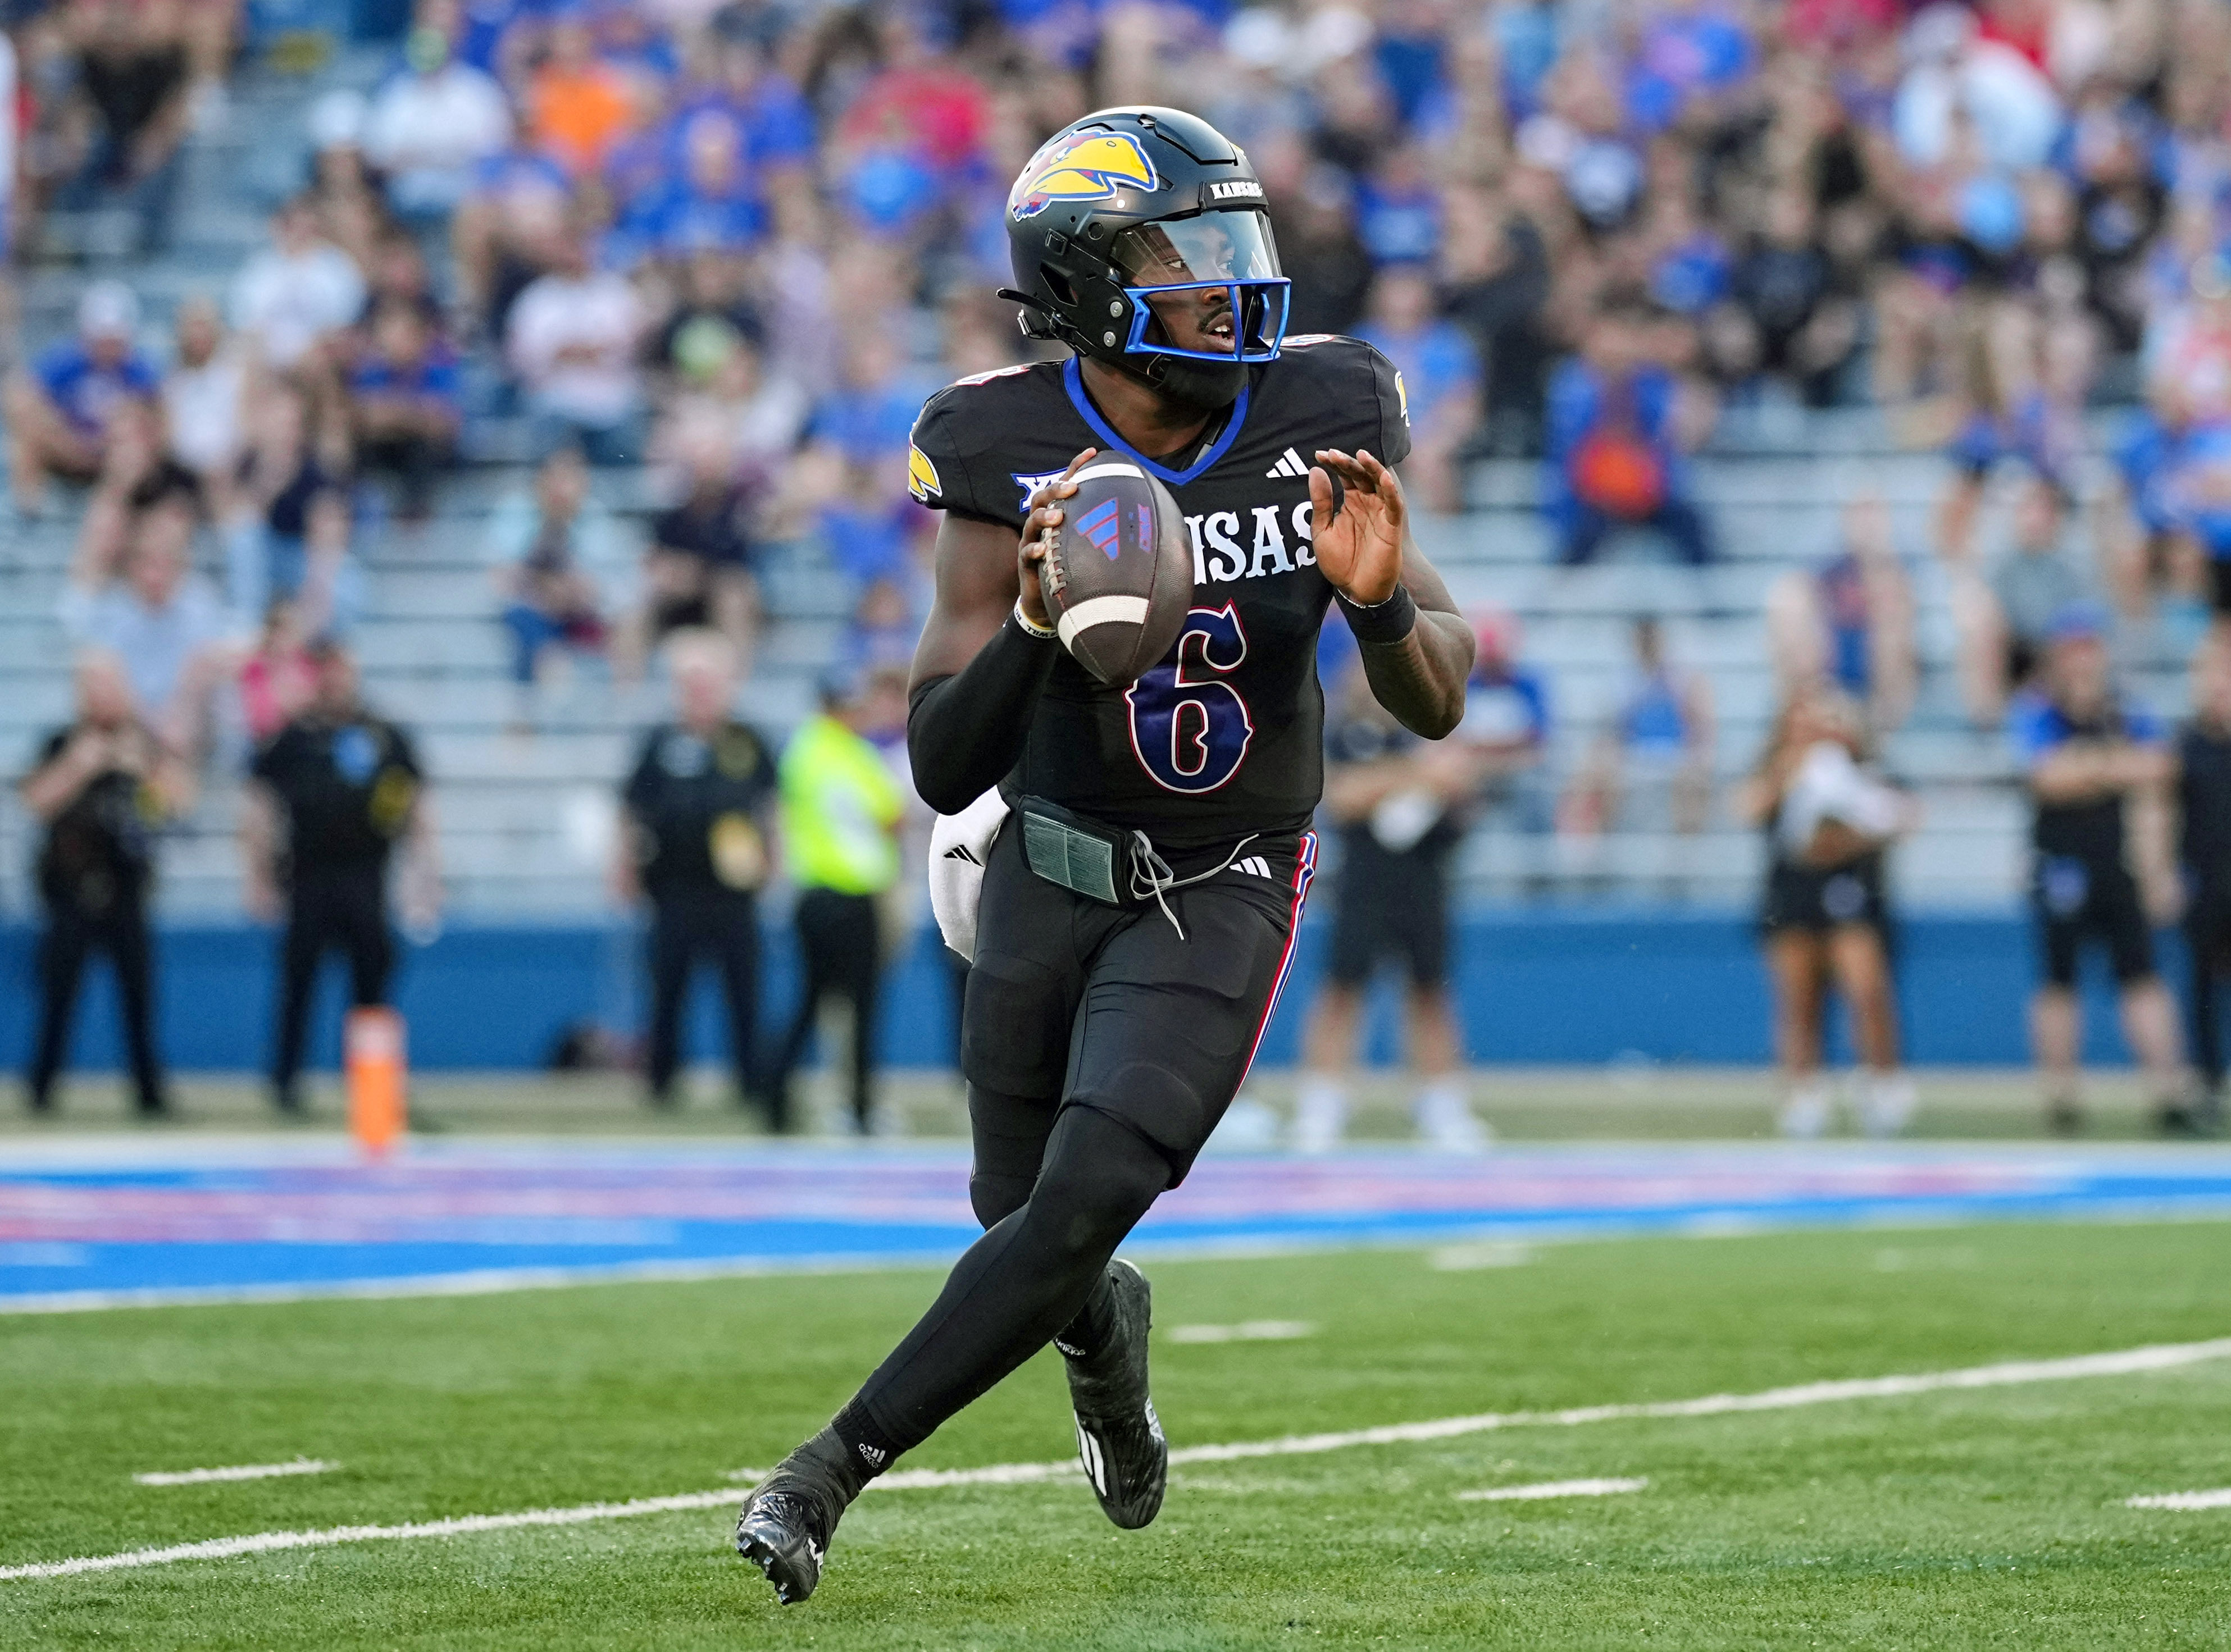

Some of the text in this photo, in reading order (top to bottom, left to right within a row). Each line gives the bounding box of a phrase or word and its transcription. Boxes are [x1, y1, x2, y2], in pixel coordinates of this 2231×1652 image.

[1027, 624, 1049, 638] WILL
[1122, 597, 1256, 795] 6
[859, 1443, 879, 1469] adidas
